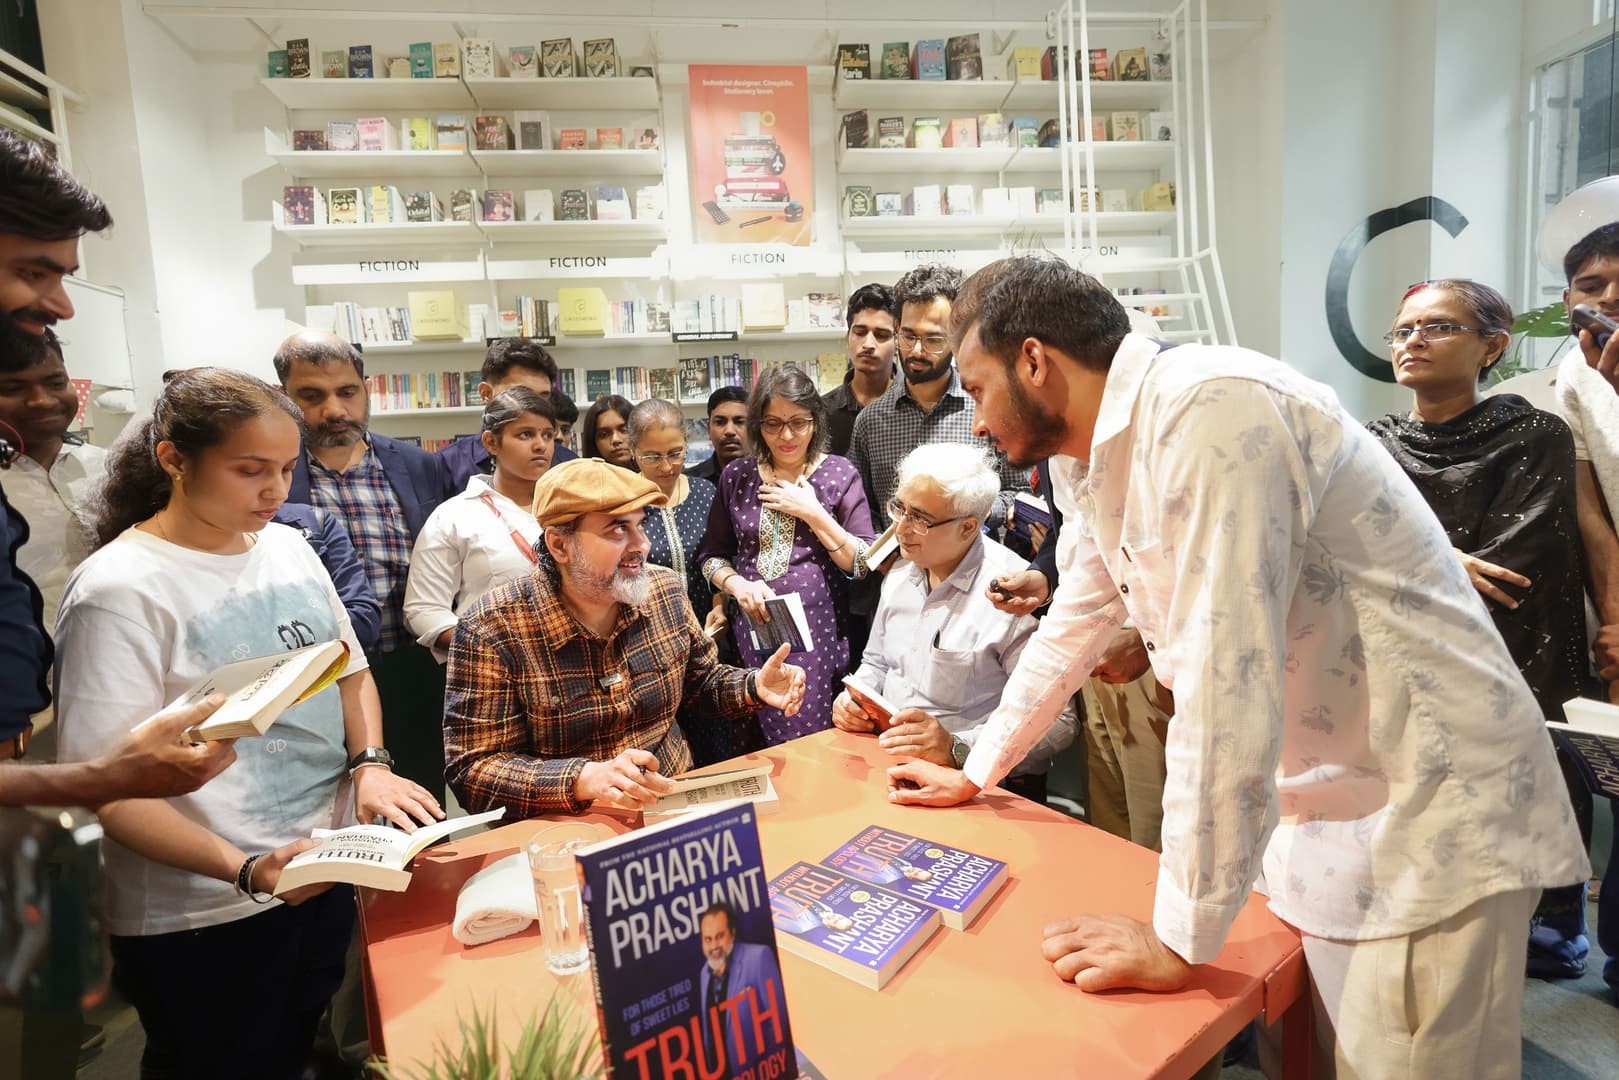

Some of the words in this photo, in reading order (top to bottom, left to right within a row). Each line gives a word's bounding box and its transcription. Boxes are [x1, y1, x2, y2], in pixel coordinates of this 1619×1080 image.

[408, 207, 430, 217] Orbital
[359, 260, 420, 272] FICTION
[549, 256, 607, 268] FICTION
[731, 253, 785, 265] FICTION
[904, 249, 956, 260] FICTION
[317, 850, 384, 863] TRUTH
[599, 857, 621, 869] FROM
[622, 851, 636, 862] THE
[637, 840, 670, 855] NATIONAL
[671, 827, 713, 844] BESTSELLING
[714, 817, 740, 831] AUTHOR
[841, 832, 917, 885] TRUTH
[606, 829, 742, 917] ACHARYA
[907, 849, 969, 900] PRASHANT
[936, 855, 993, 898] ACHARYA
[609, 867, 761, 968] PRASHANT
[769, 870, 845, 927] TRUTH
[822, 891, 899, 954] PRASHANT
[853, 899, 923, 956] ACHARYA
[622, 1002, 641, 1022] FOR
[641, 990, 668, 1011] THOSE
[669, 978, 692, 1001] TIRED
[630, 1021, 643, 1037] OF
[642, 1007, 672, 1031] SWEET
[672, 996, 691, 1018] LIES
[624, 977, 784, 1080] TRUTH
